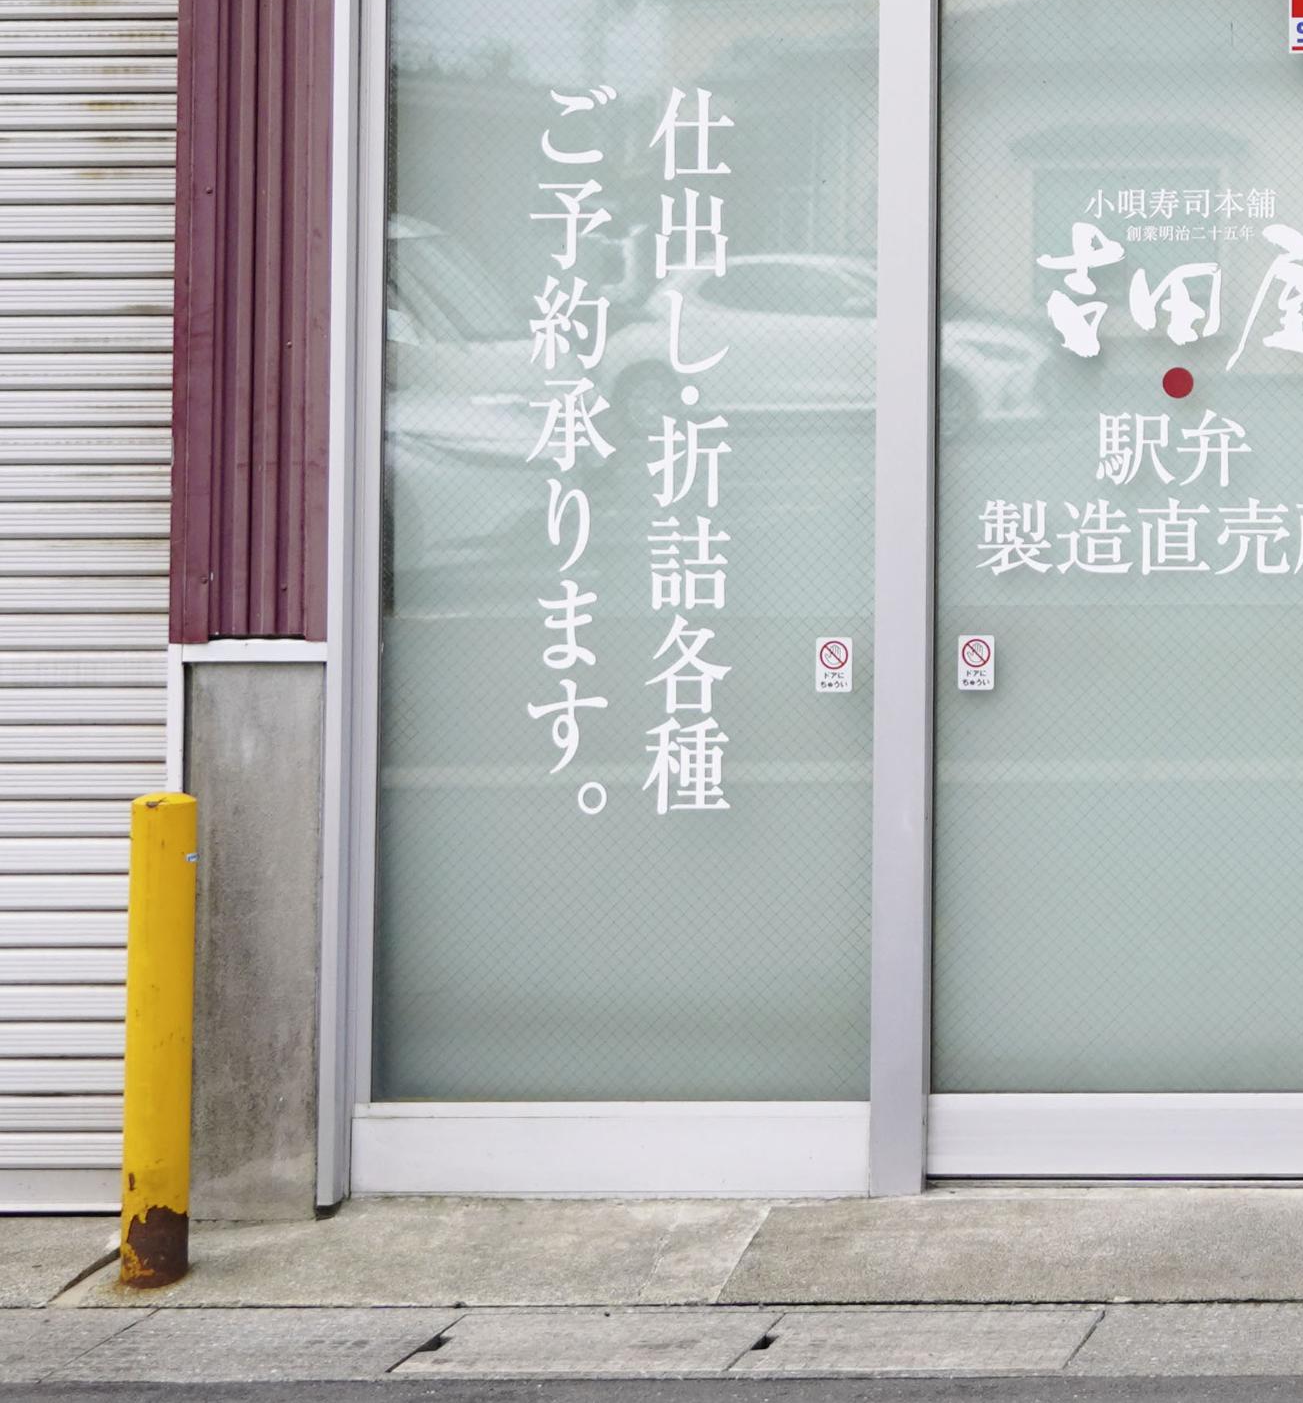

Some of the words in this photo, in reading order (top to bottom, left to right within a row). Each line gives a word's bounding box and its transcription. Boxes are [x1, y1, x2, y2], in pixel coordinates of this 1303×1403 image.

[1084, 188, 1277, 219] 小唄寿司本舗
[1126, 225, 1255, 242] 創業明治二十五年
[525, 84, 617, 817] ご予約承ります。
[642, 85, 736, 816] 仕出し・折詰各種
[1095, 408, 1253, 487] 駅弁
[823, 672, 844, 680] ドアに
[965, 669, 987, 677] ドアに
[820, 680, 848, 688] ちゅうい
[962, 678, 990, 686] ちゅうい
